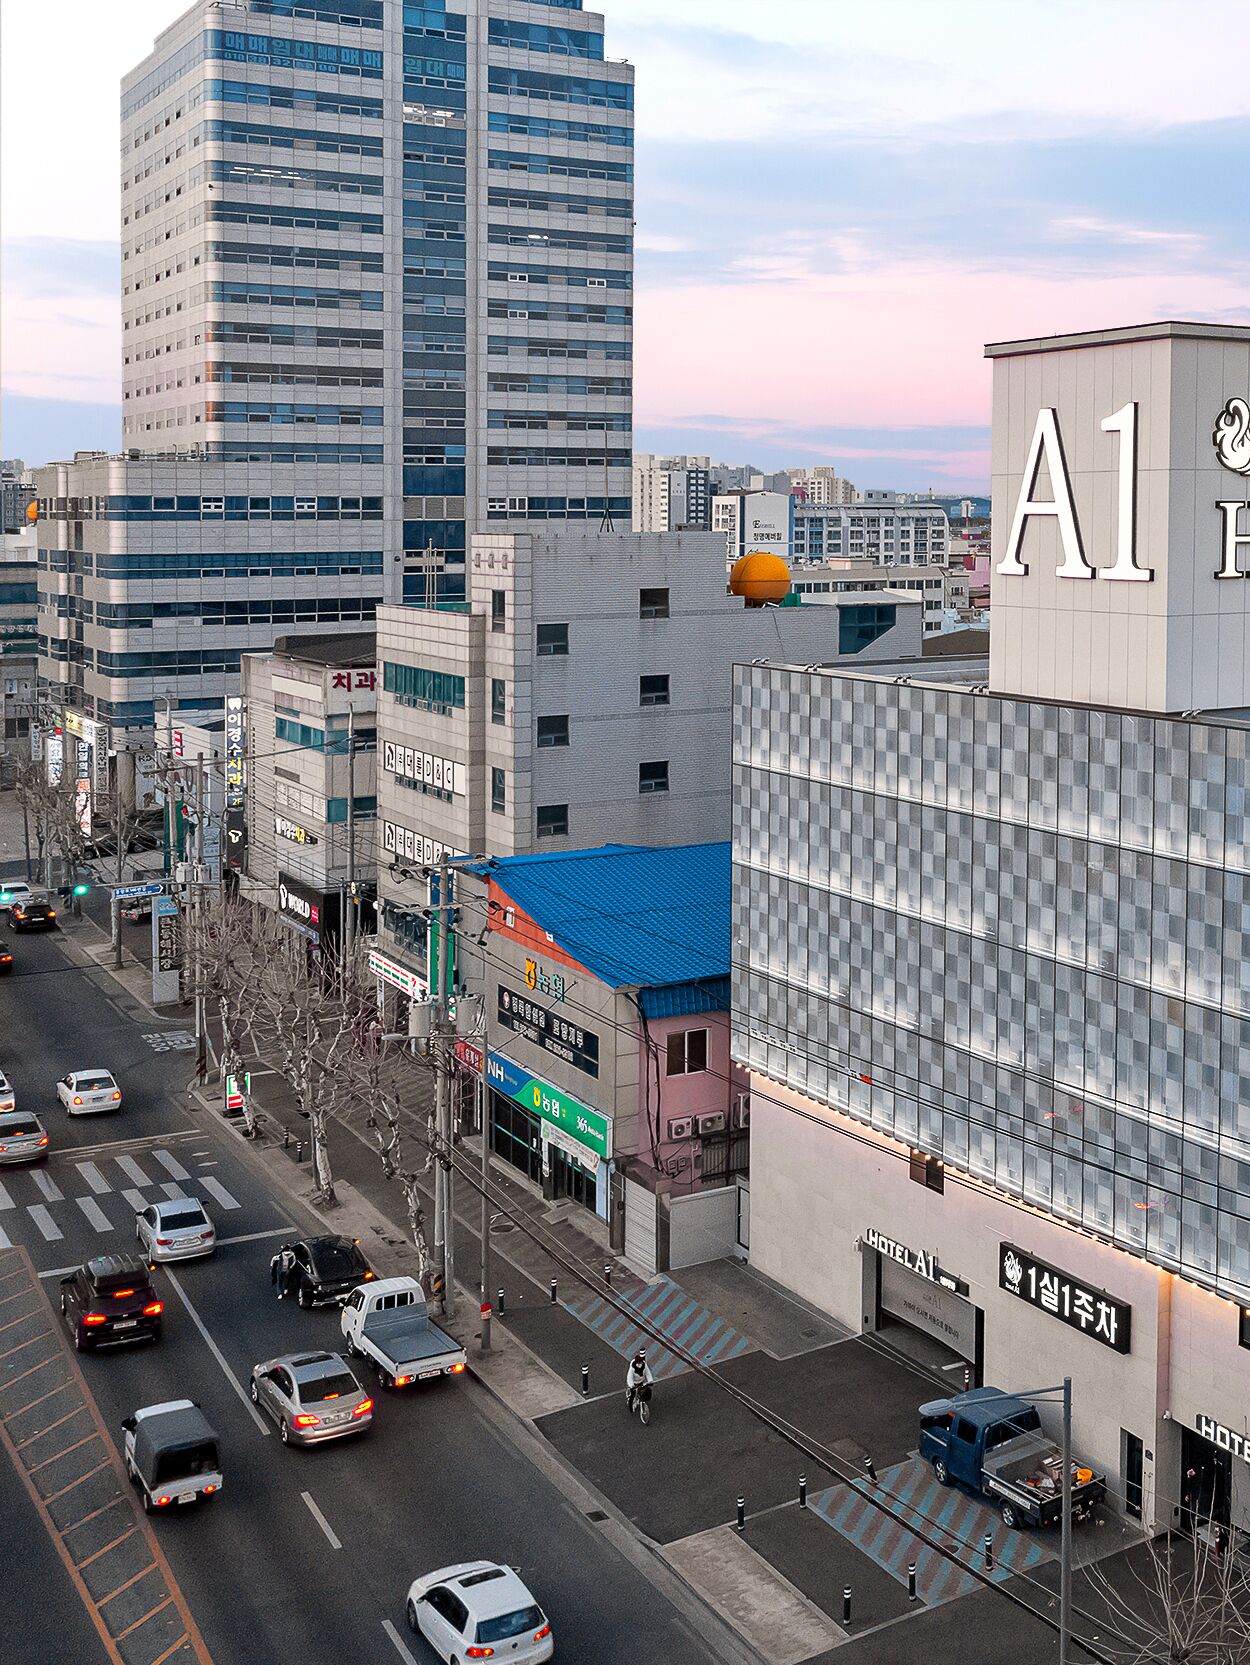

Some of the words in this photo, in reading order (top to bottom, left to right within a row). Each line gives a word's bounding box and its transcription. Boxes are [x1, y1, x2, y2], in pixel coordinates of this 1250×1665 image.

[995, 401, 1156, 583] A1
[332, 671, 378, 692] 치과
[487, 1057, 504, 1083] NH
[543, 1093, 560, 1119] 농협
[867, 1228, 913, 1270] HOTEL
[914, 1249, 936, 1282] A1
[1027, 1266, 1118, 1345] 1실1주차
